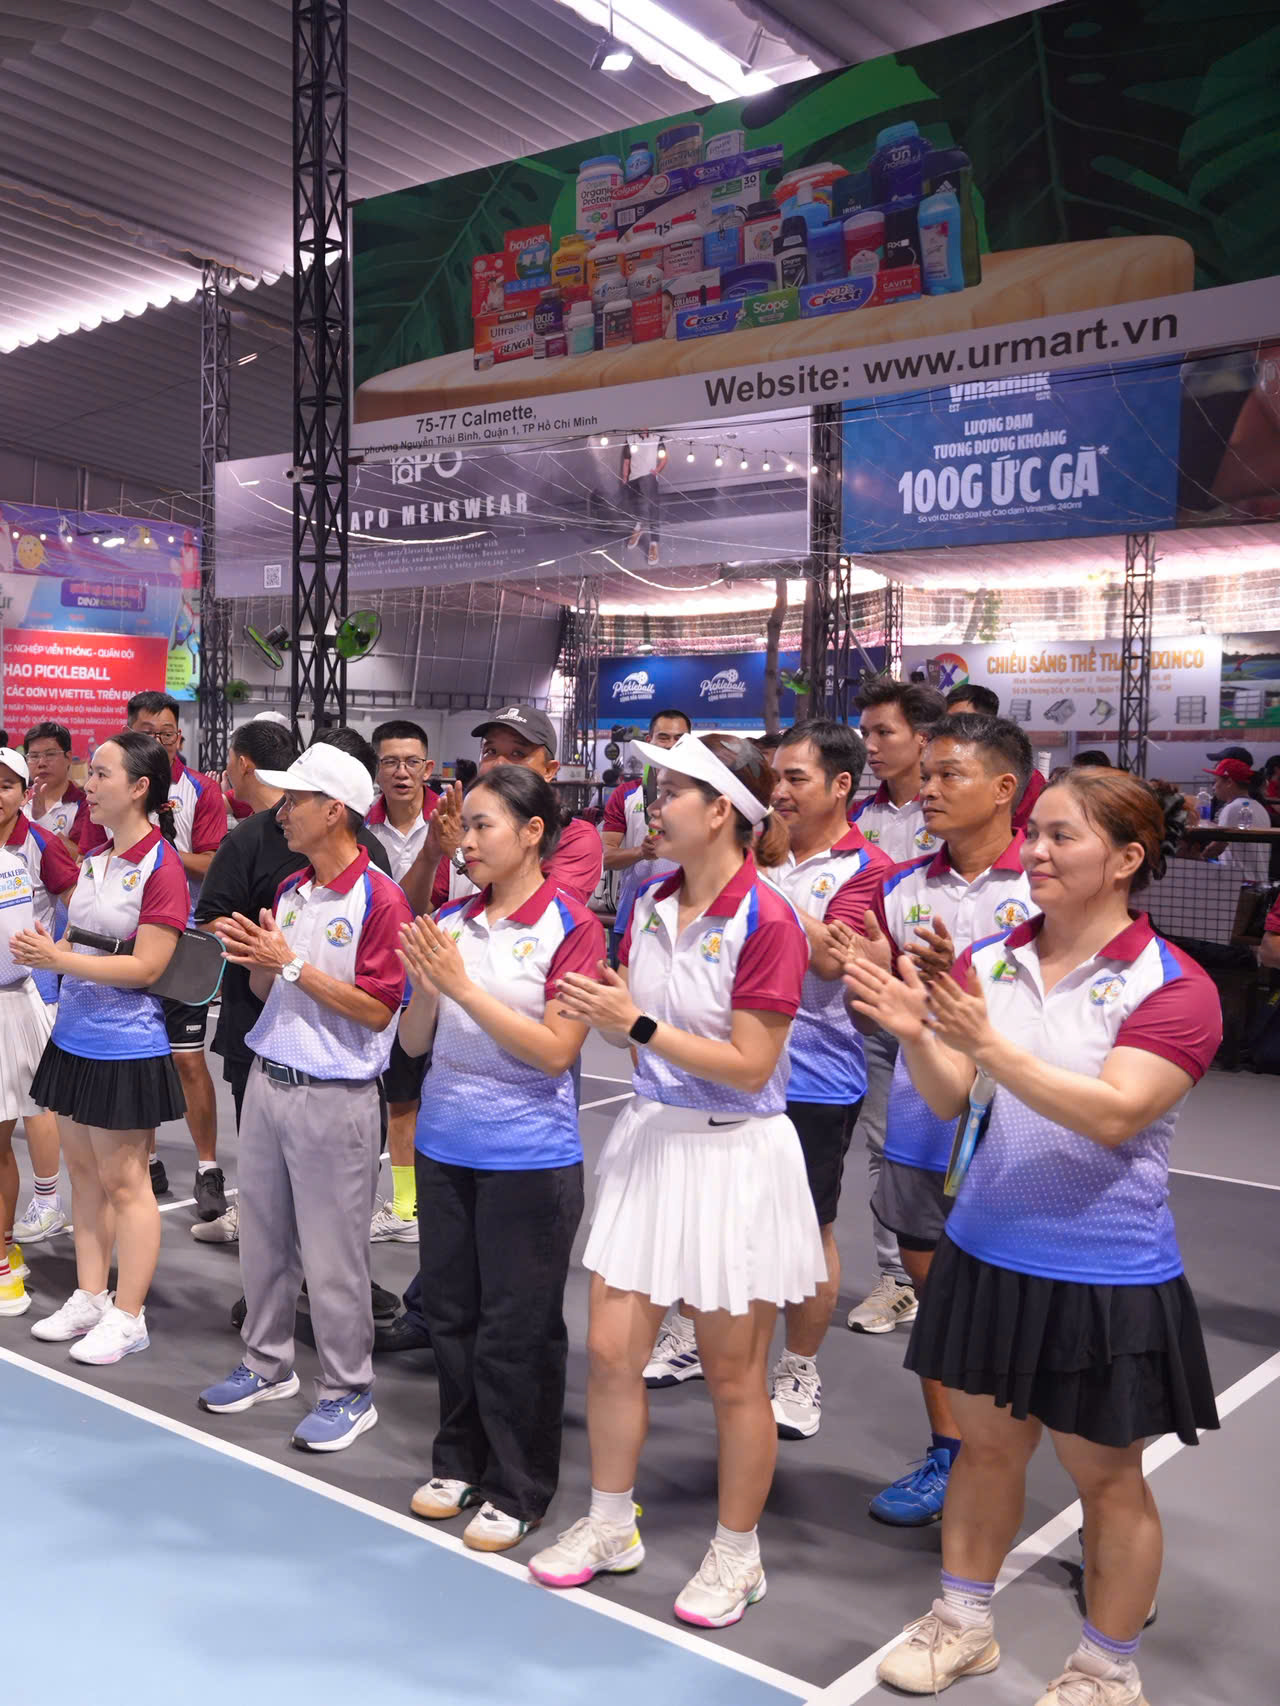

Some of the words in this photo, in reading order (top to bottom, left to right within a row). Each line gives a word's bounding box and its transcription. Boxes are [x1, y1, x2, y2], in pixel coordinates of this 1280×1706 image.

[753, 299, 789, 313] Scope
[685, 310, 729, 328] Crest
[705, 364, 850, 407] Website:
[864, 313, 1179, 384] www.urmart.vn
[416, 415, 456, 433] 75-77
[462, 406, 537, 427] Calmette,
[484, 428, 508, 440] Quận
[523, 424, 535, 433] TP
[574, 415, 598, 427] Minh
[898, 464, 983, 514] 100G
[991, 454, 1042, 506] ỨC
[402, 492, 528, 526] MENSWEAR
[987, 650, 1026, 675] CHIẾU
[1029, 650, 1067, 673] SÁNG
[1070, 646, 1097, 673] THỂ
[4, 663, 32, 677] HAO
[34, 664, 111, 681] PICKLEBALL
[7, 685, 25, 698] CÁC
[60, 688, 96, 700] VIETTEL
[612, 679, 655, 698] Pickleball
[699, 678, 746, 697] Pickleball
